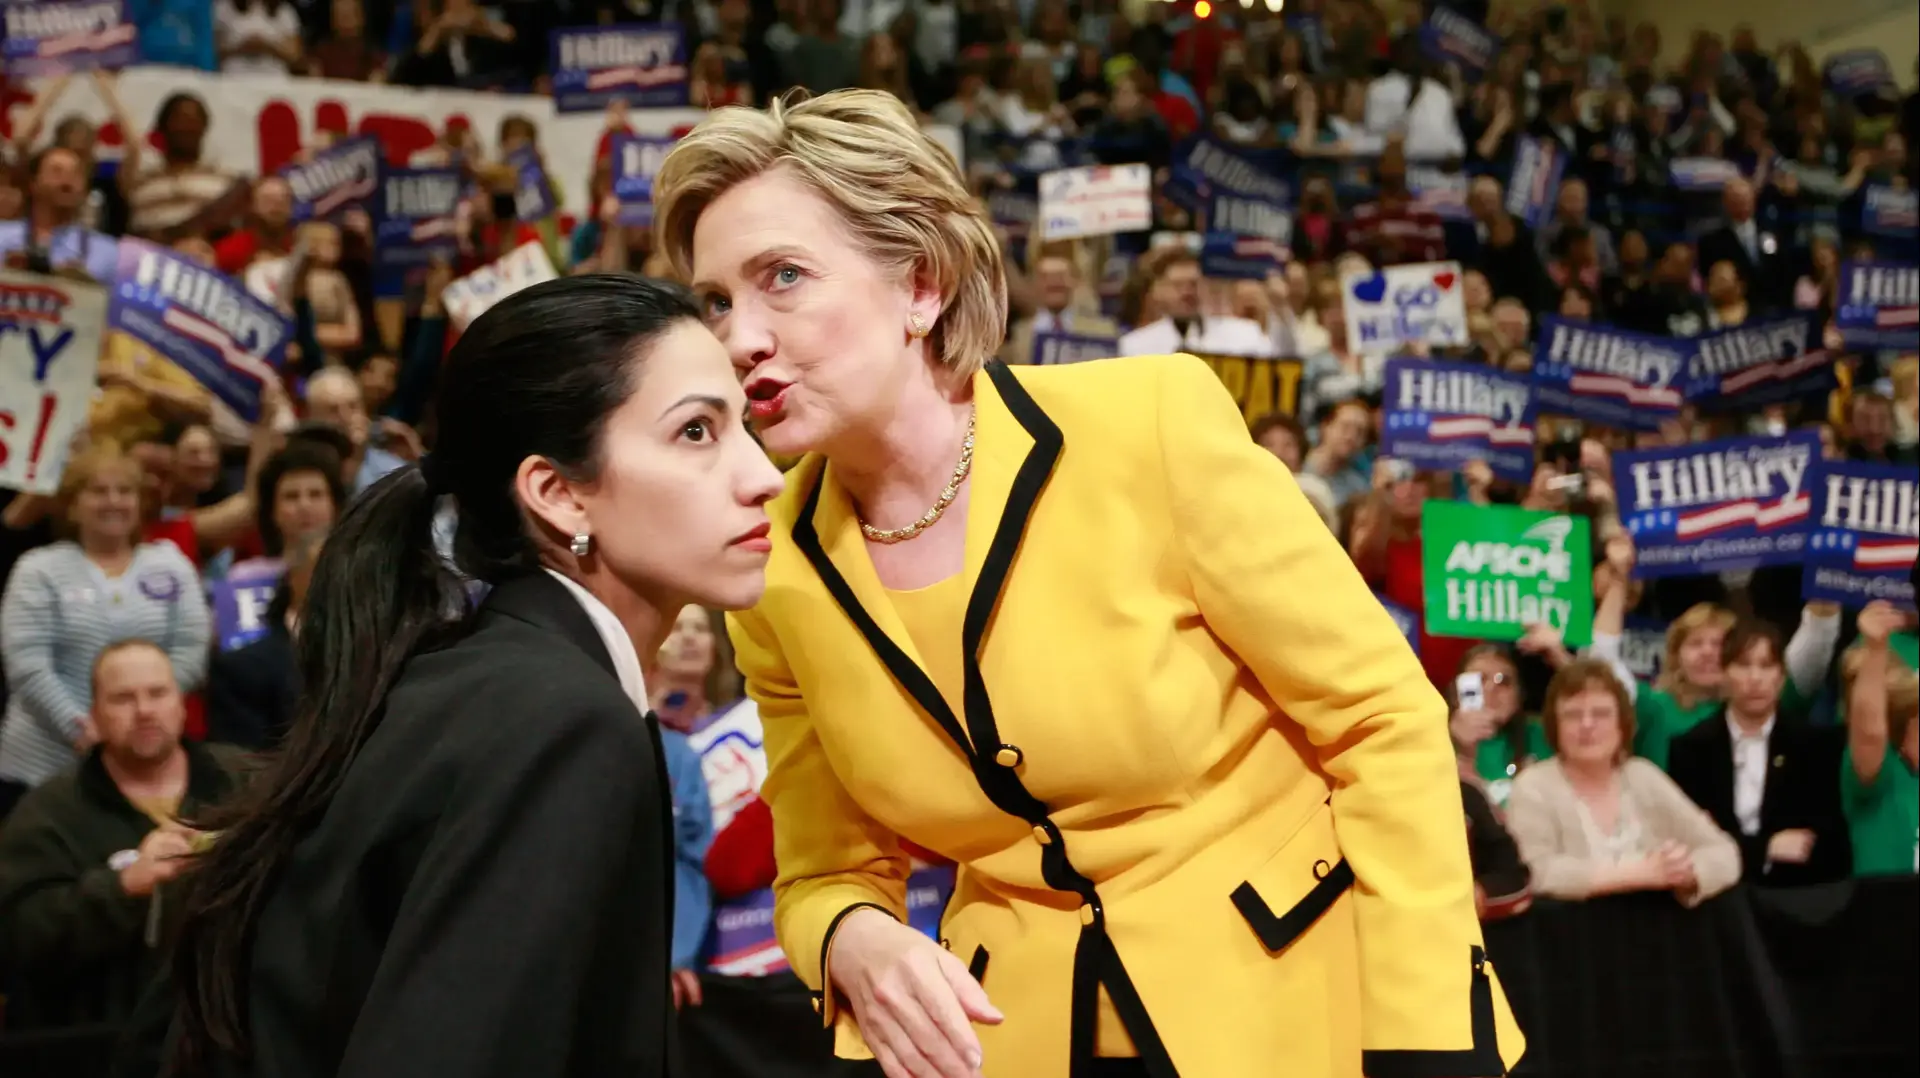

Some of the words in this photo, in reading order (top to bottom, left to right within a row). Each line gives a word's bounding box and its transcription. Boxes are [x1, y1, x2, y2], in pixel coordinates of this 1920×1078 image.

[136, 252, 284, 358] Hillary
[1549, 325, 1682, 396] Hillary
[1398, 368, 1529, 434] Hillary
[1630, 452, 1810, 507] Hillary
[1446, 577, 1572, 640] Hillary
